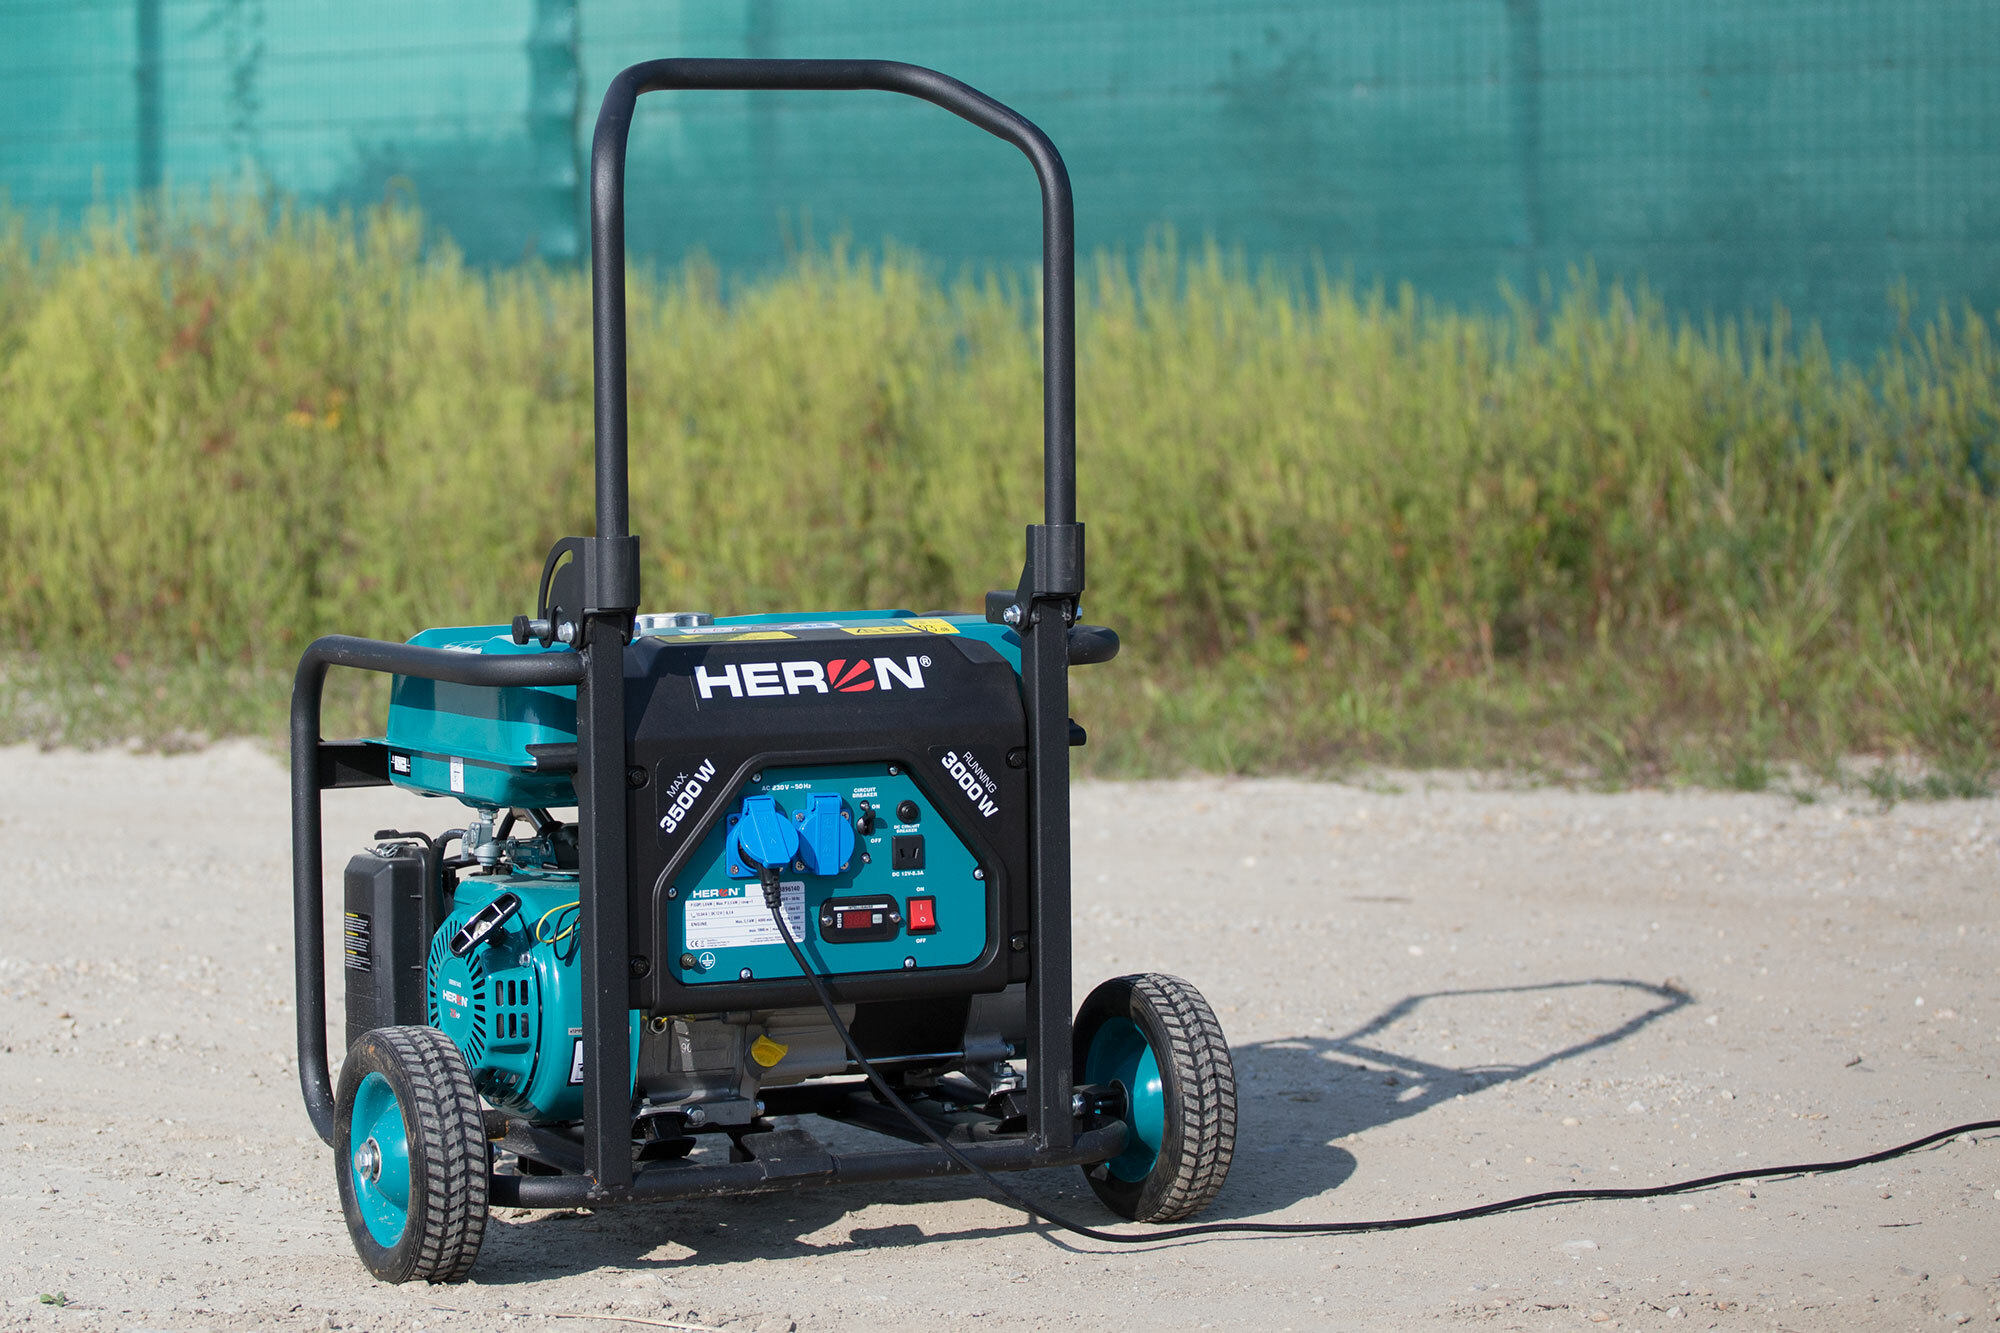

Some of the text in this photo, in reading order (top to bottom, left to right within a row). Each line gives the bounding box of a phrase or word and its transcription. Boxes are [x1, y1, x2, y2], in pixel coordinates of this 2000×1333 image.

[659, 758, 716, 834] 3500 W
[666, 772, 689, 798] MAX.
[941, 751, 999, 818] 3000 W
[962, 751, 997, 794] RUNNING
